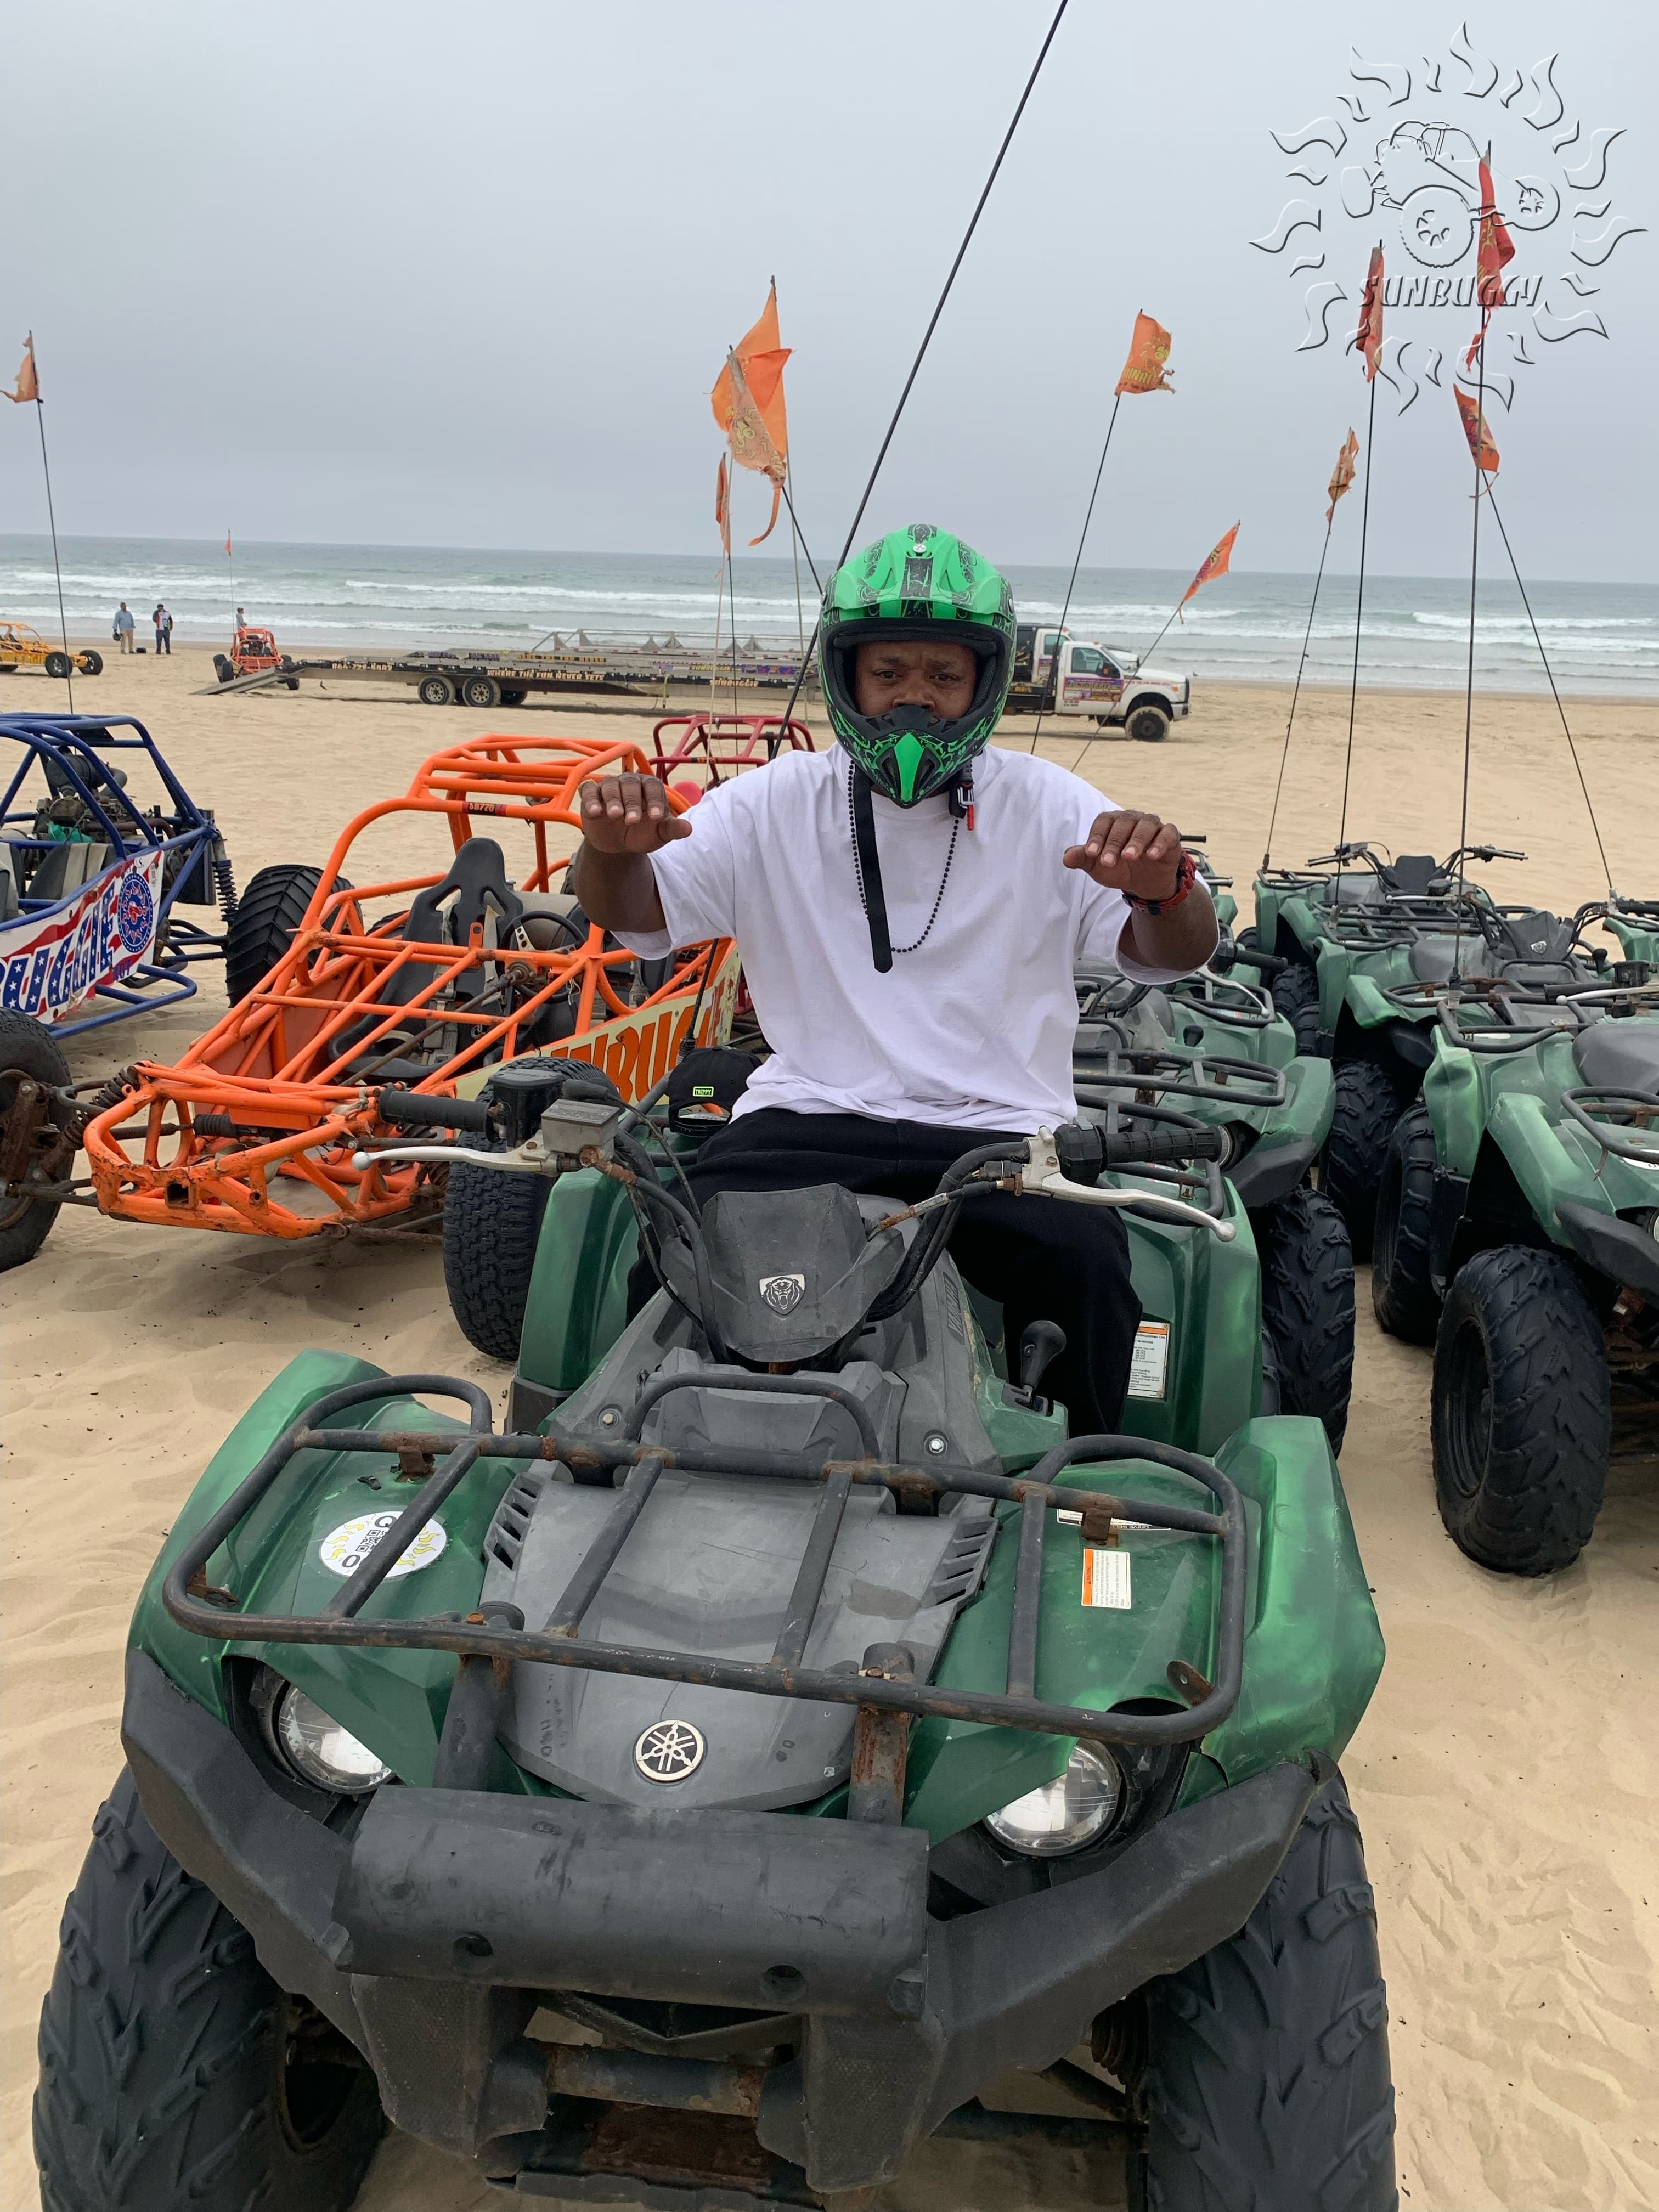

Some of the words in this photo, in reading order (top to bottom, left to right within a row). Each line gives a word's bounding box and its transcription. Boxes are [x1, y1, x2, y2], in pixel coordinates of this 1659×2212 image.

[536, 672, 554, 680] FUN
[555, 672, 583, 680] NEVER
[585, 673, 604, 681] SETS
